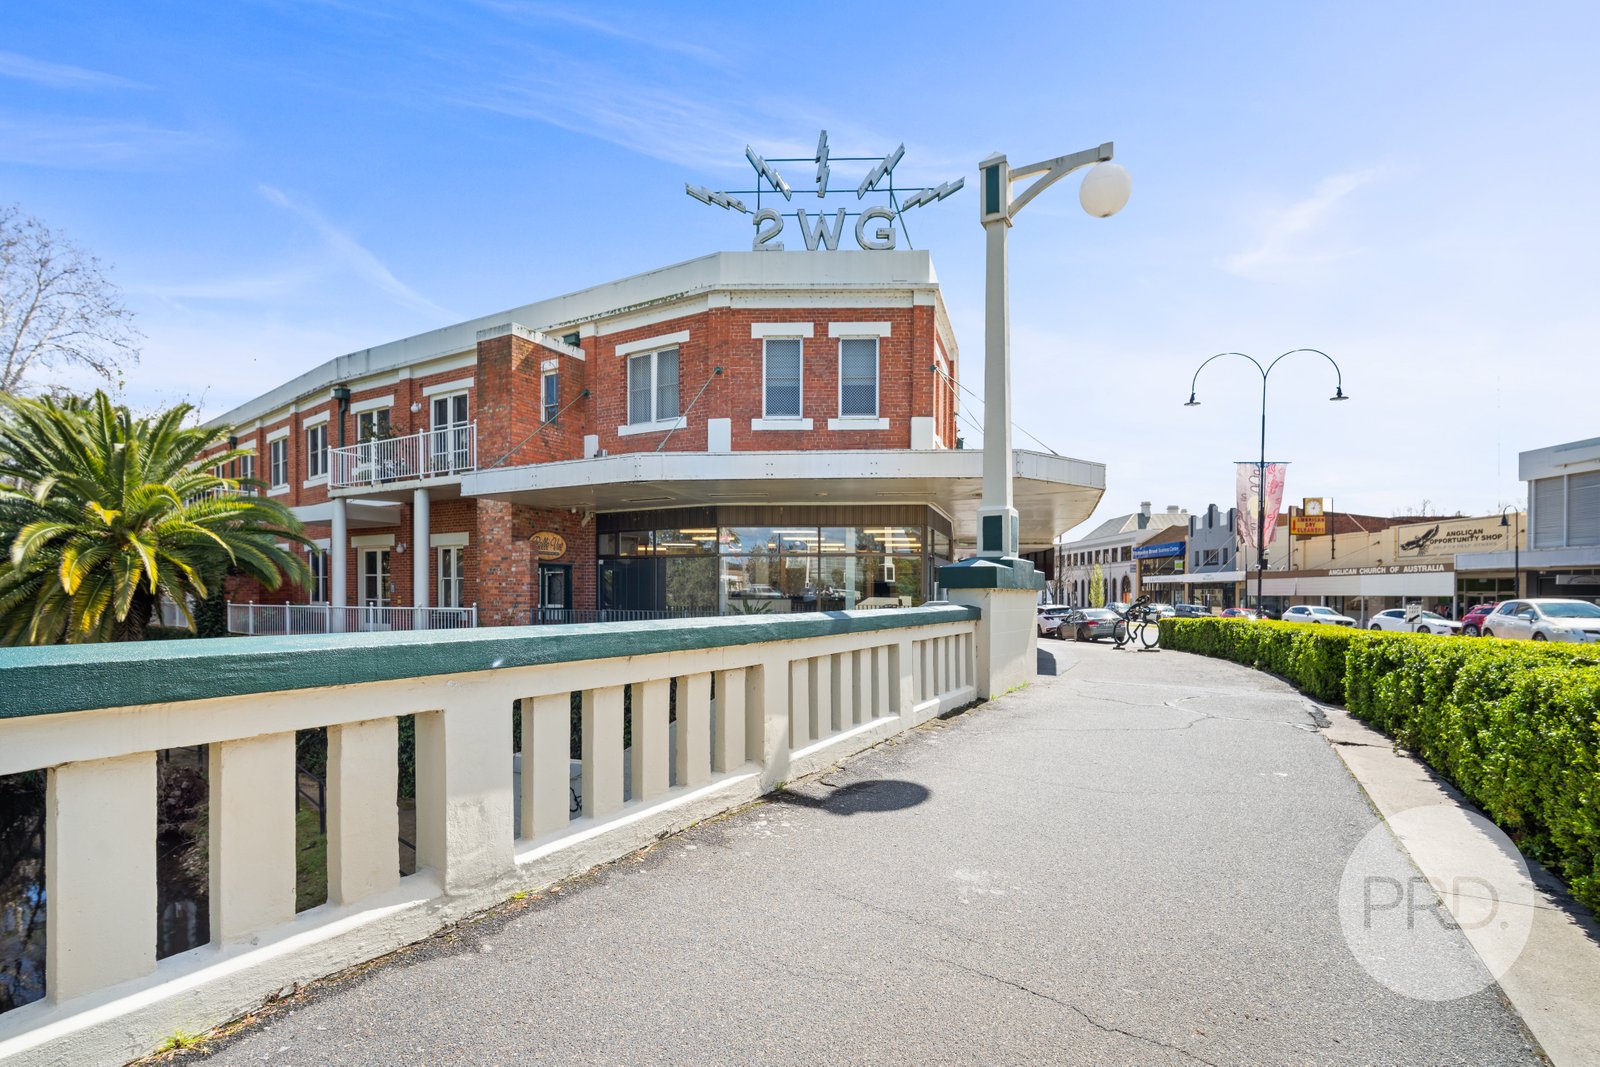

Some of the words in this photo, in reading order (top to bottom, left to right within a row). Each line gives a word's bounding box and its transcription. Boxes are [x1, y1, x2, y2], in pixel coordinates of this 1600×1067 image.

[752, 205, 896, 251] 2WG
[1446, 528, 1484, 537] ANGLICAN
[1429, 535, 1479, 545] OPPORTUNITY
[1481, 533, 1503, 541] SHOP
[1328, 568, 1357, 576] ANGLICAN
[1359, 566, 1386, 574] CHURCH
[1403, 564, 1445, 573] AUSTRALIA
